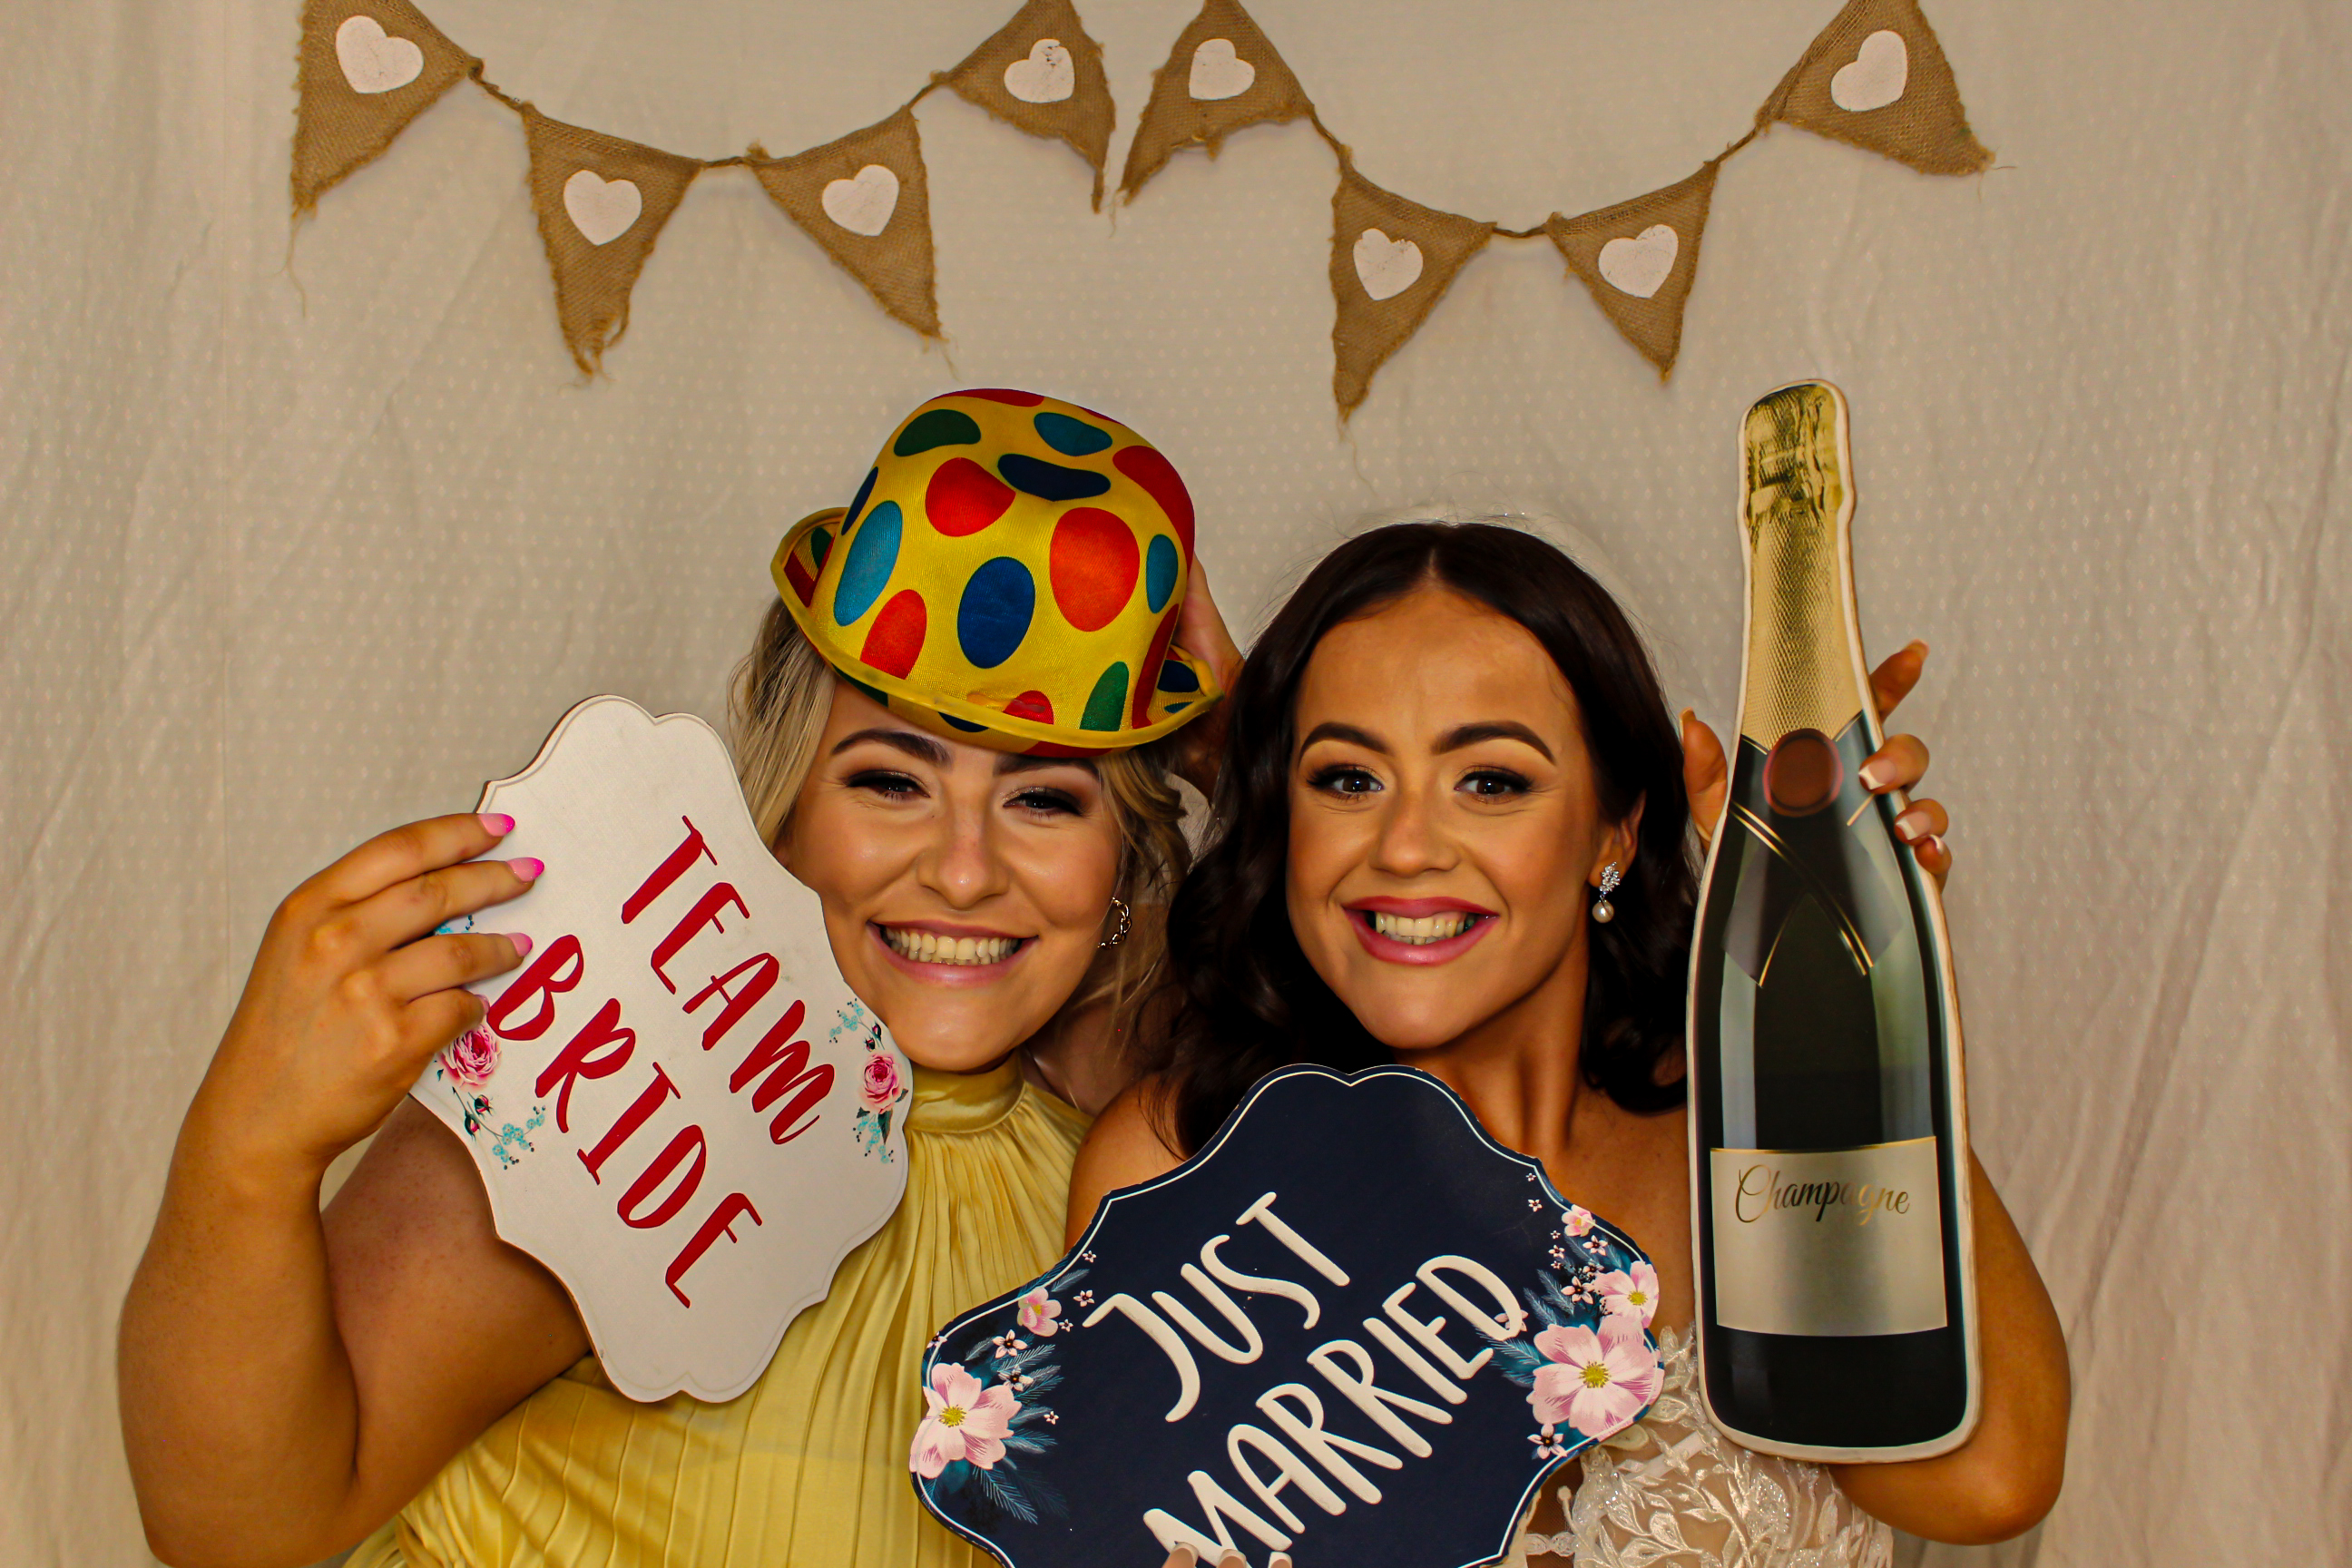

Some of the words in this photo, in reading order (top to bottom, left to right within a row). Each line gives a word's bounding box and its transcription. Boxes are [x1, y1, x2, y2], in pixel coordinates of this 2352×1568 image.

[486, 935, 762, 1308] BRIDE
[622, 816, 835, 1144] TEAM
[1083, 1191, 1350, 1423] JUST
[1735, 1164, 1910, 1226] Champagne
[1142, 1255, 1522, 1568] MARRIED
